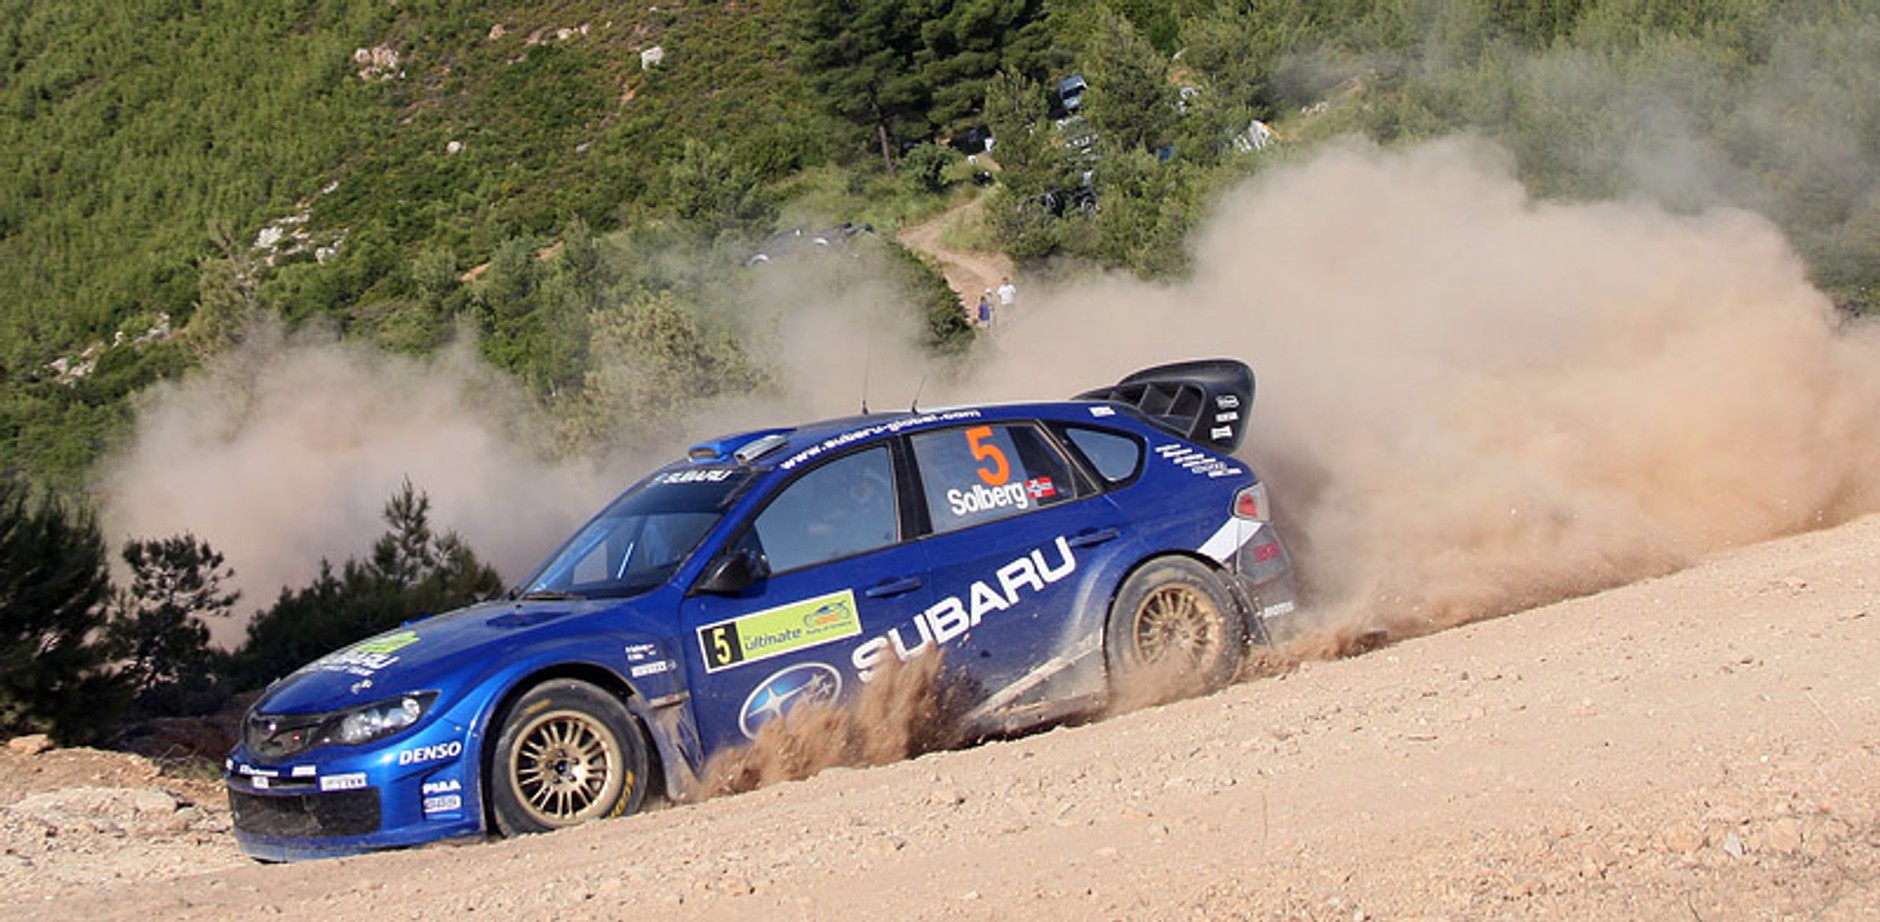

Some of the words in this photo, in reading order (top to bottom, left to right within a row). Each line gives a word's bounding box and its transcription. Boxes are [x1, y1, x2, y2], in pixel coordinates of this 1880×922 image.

[781, 409, 981, 470] www.subaru-global.com
[965, 426, 1011, 487] 5
[947, 482, 1028, 516] Solberg
[852, 536, 1077, 684] SUBARU
[712, 628, 731, 664] 5
[744, 628, 802, 651] ultimate
[399, 741, 462, 765] DENSO
[423, 779, 462, 795] PIAA
